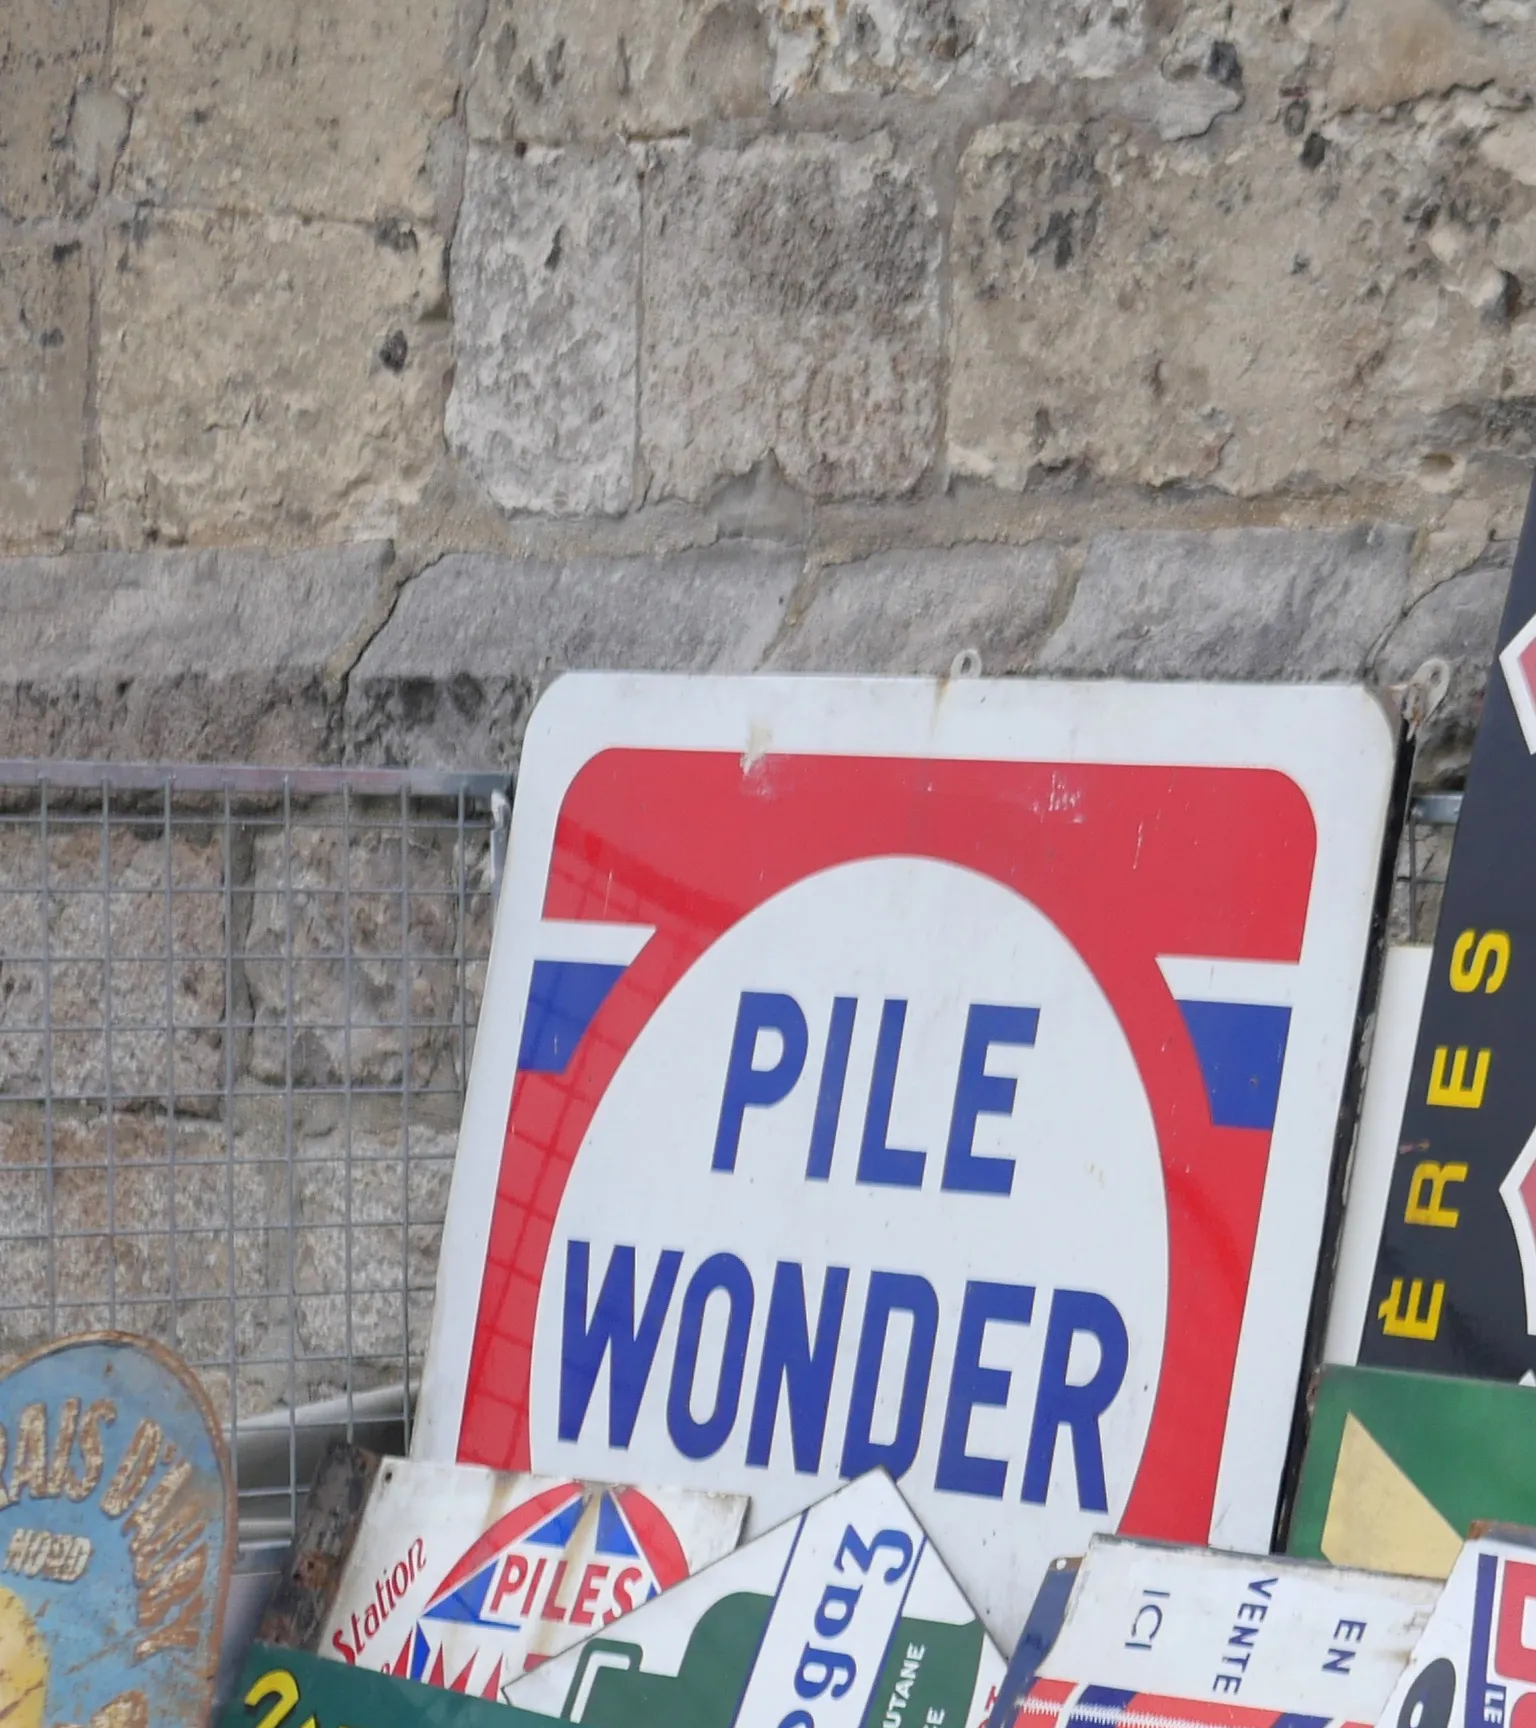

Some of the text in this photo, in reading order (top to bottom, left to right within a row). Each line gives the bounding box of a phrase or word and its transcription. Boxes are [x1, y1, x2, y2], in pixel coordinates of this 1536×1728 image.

[711, 990, 1040, 1196] PILE
[557, 1240, 1129, 1512] WONDER
[332, 1537, 428, 1666] Station
[489, 1554, 644, 1627] PILES
[1125, 1589, 1170, 1652] ICI
[1213, 1577, 1279, 1695] VENTE
[1322, 1619, 1367, 1675] EN
[1483, 1686, 1504, 1724] LE
